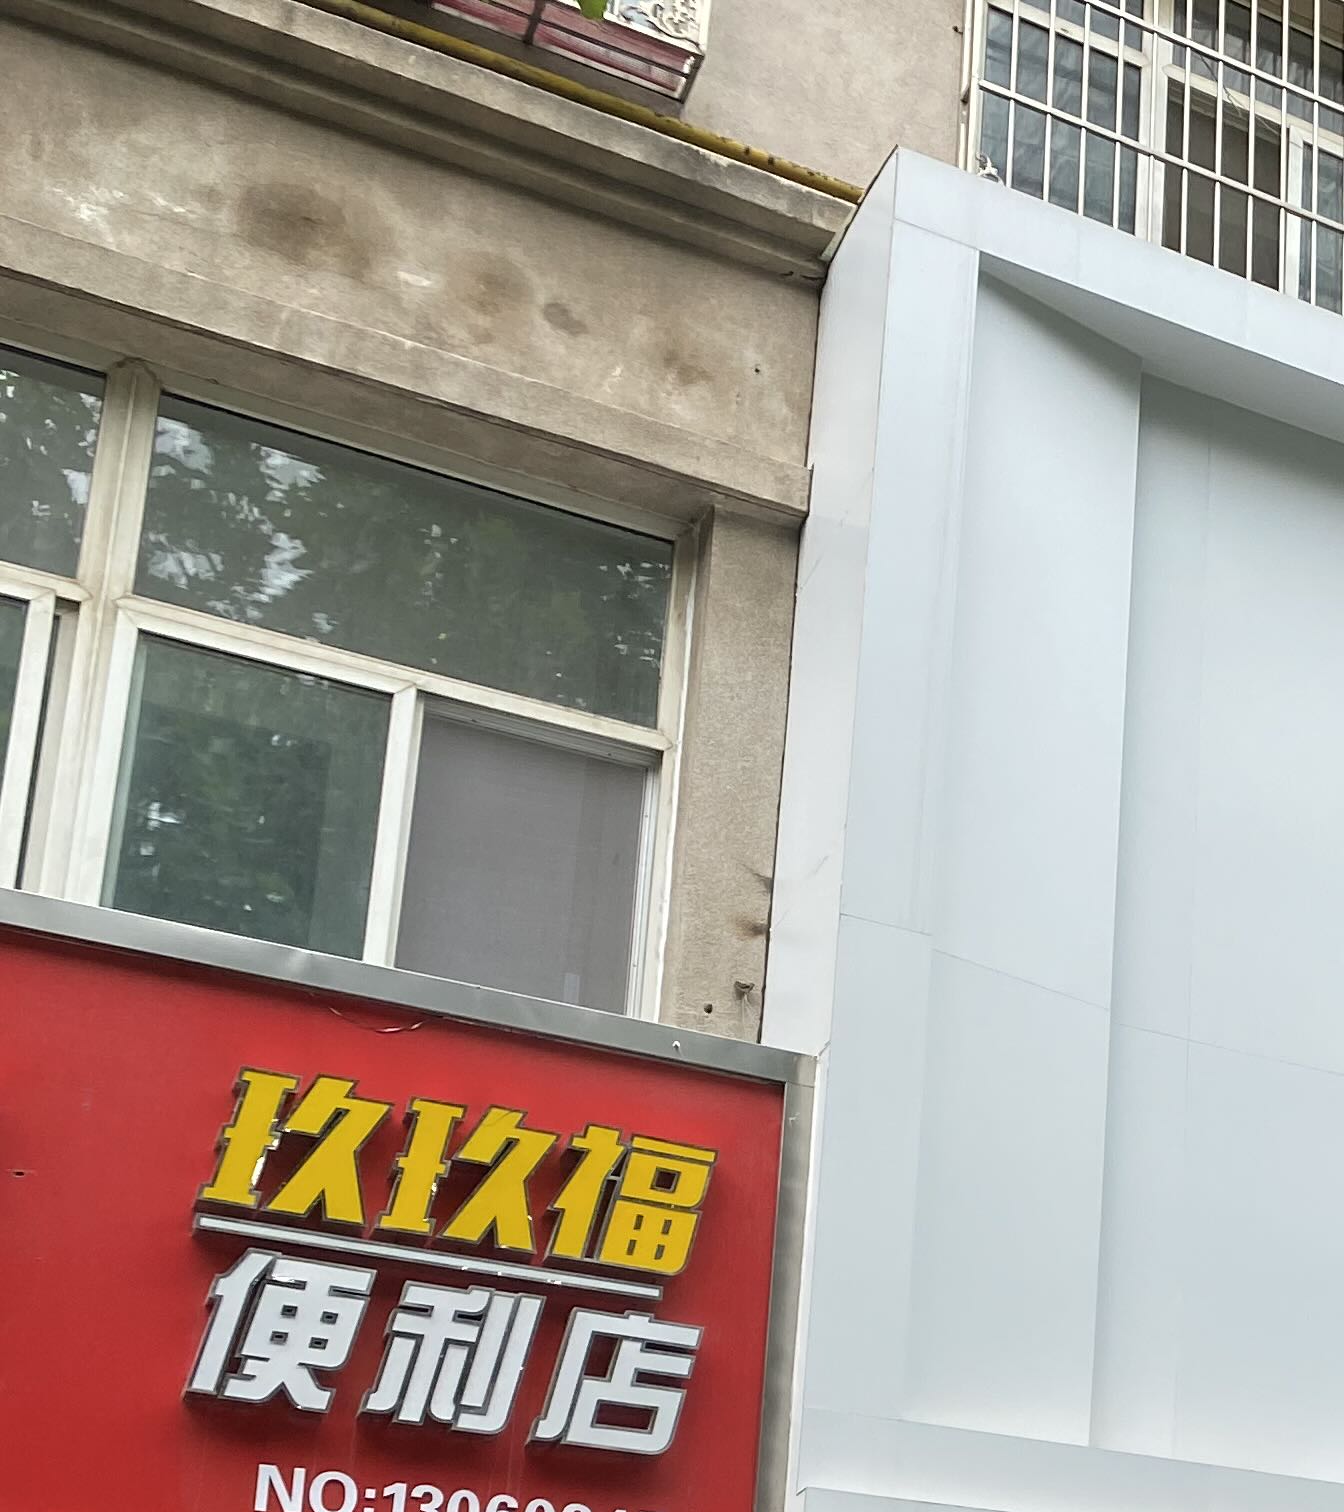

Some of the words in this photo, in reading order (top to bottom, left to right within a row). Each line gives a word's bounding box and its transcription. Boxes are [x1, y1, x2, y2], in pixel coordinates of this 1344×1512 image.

[198, 1066, 719, 1276] 玖玖福
[183, 1247, 704, 1457] 便利店
